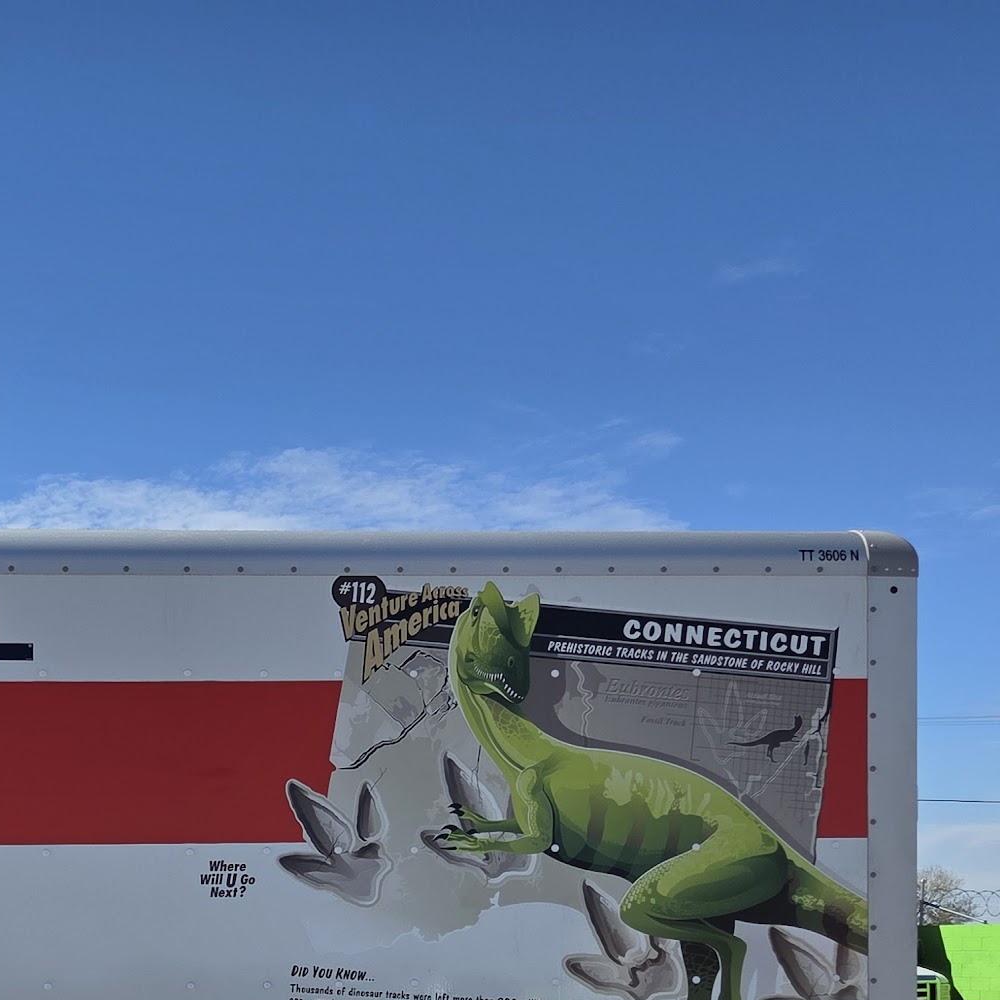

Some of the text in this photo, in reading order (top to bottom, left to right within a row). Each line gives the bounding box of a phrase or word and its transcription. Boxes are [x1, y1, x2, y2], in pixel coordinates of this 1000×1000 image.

[798, 549, 859, 561] TT 3606 N
[338, 581, 376, 604] #112
[340, 583, 469, 640] Venture Across
[363, 600, 460, 682] America
[623, 619, 826, 657] CONNECTICUT
[547, 640, 822, 675] PREHISTORIC TRACKS IN THE SANDSTONE OF ROCKY HILL
[605, 678, 690, 701] Eubrontes
[665, 717, 687, 727] Track
[209, 860, 246, 872] Where
[200, 873, 256, 888] Will U Go
[290, 983, 333, 995] Thousands
[336, 986, 346, 996] of
[348, 987, 383, 998] dinosaur
[386, 990, 410, 1000] tracks
[413, 993, 432, 1000] were
